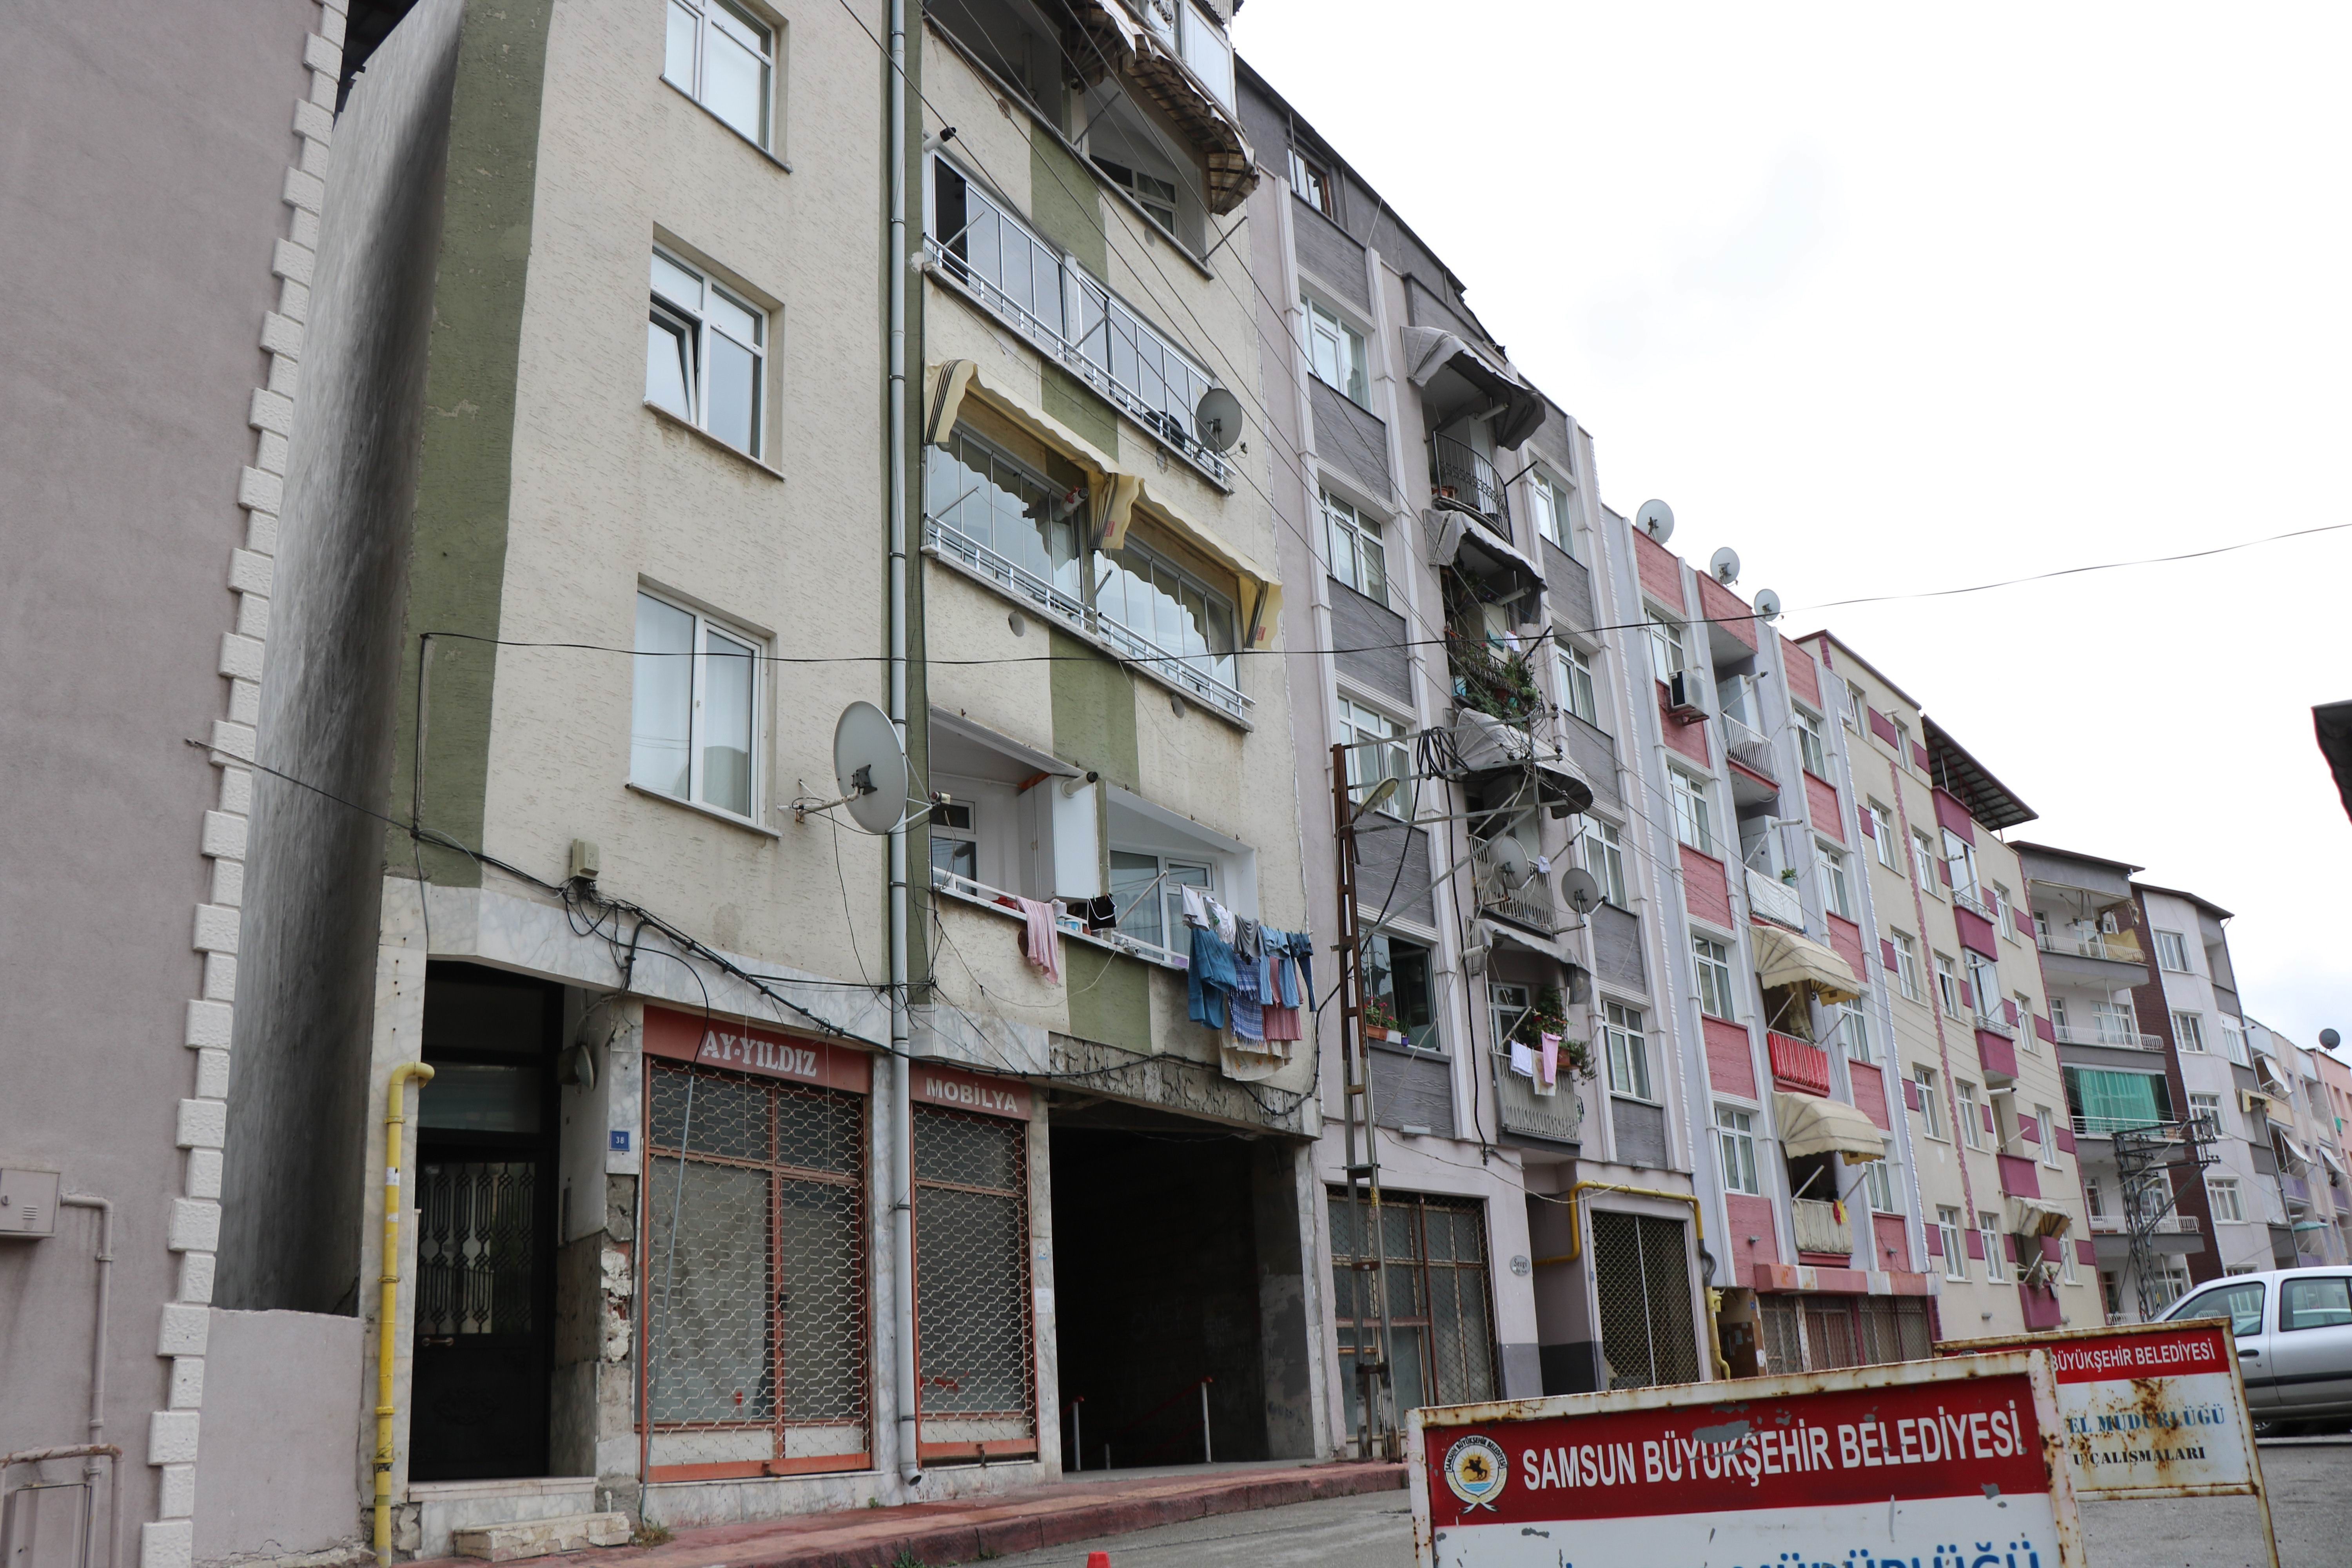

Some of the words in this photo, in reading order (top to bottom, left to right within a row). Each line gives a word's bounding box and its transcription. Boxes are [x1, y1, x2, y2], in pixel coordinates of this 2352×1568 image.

[926, 1077, 1018, 1112] MOBİLYA
[2052, 1345, 2133, 1372] BÜYÜKŞEHİR
[2135, 1338, 2216, 1365] BELEDİYESİ
[1523, 1442, 1637, 1490] SAMSUN
[1837, 1399, 2023, 1468] BELEDİYESİ
[2073, 1454, 2083, 1466] U
[2089, 1446, 2206, 1468] ÇALIŞMALARI
